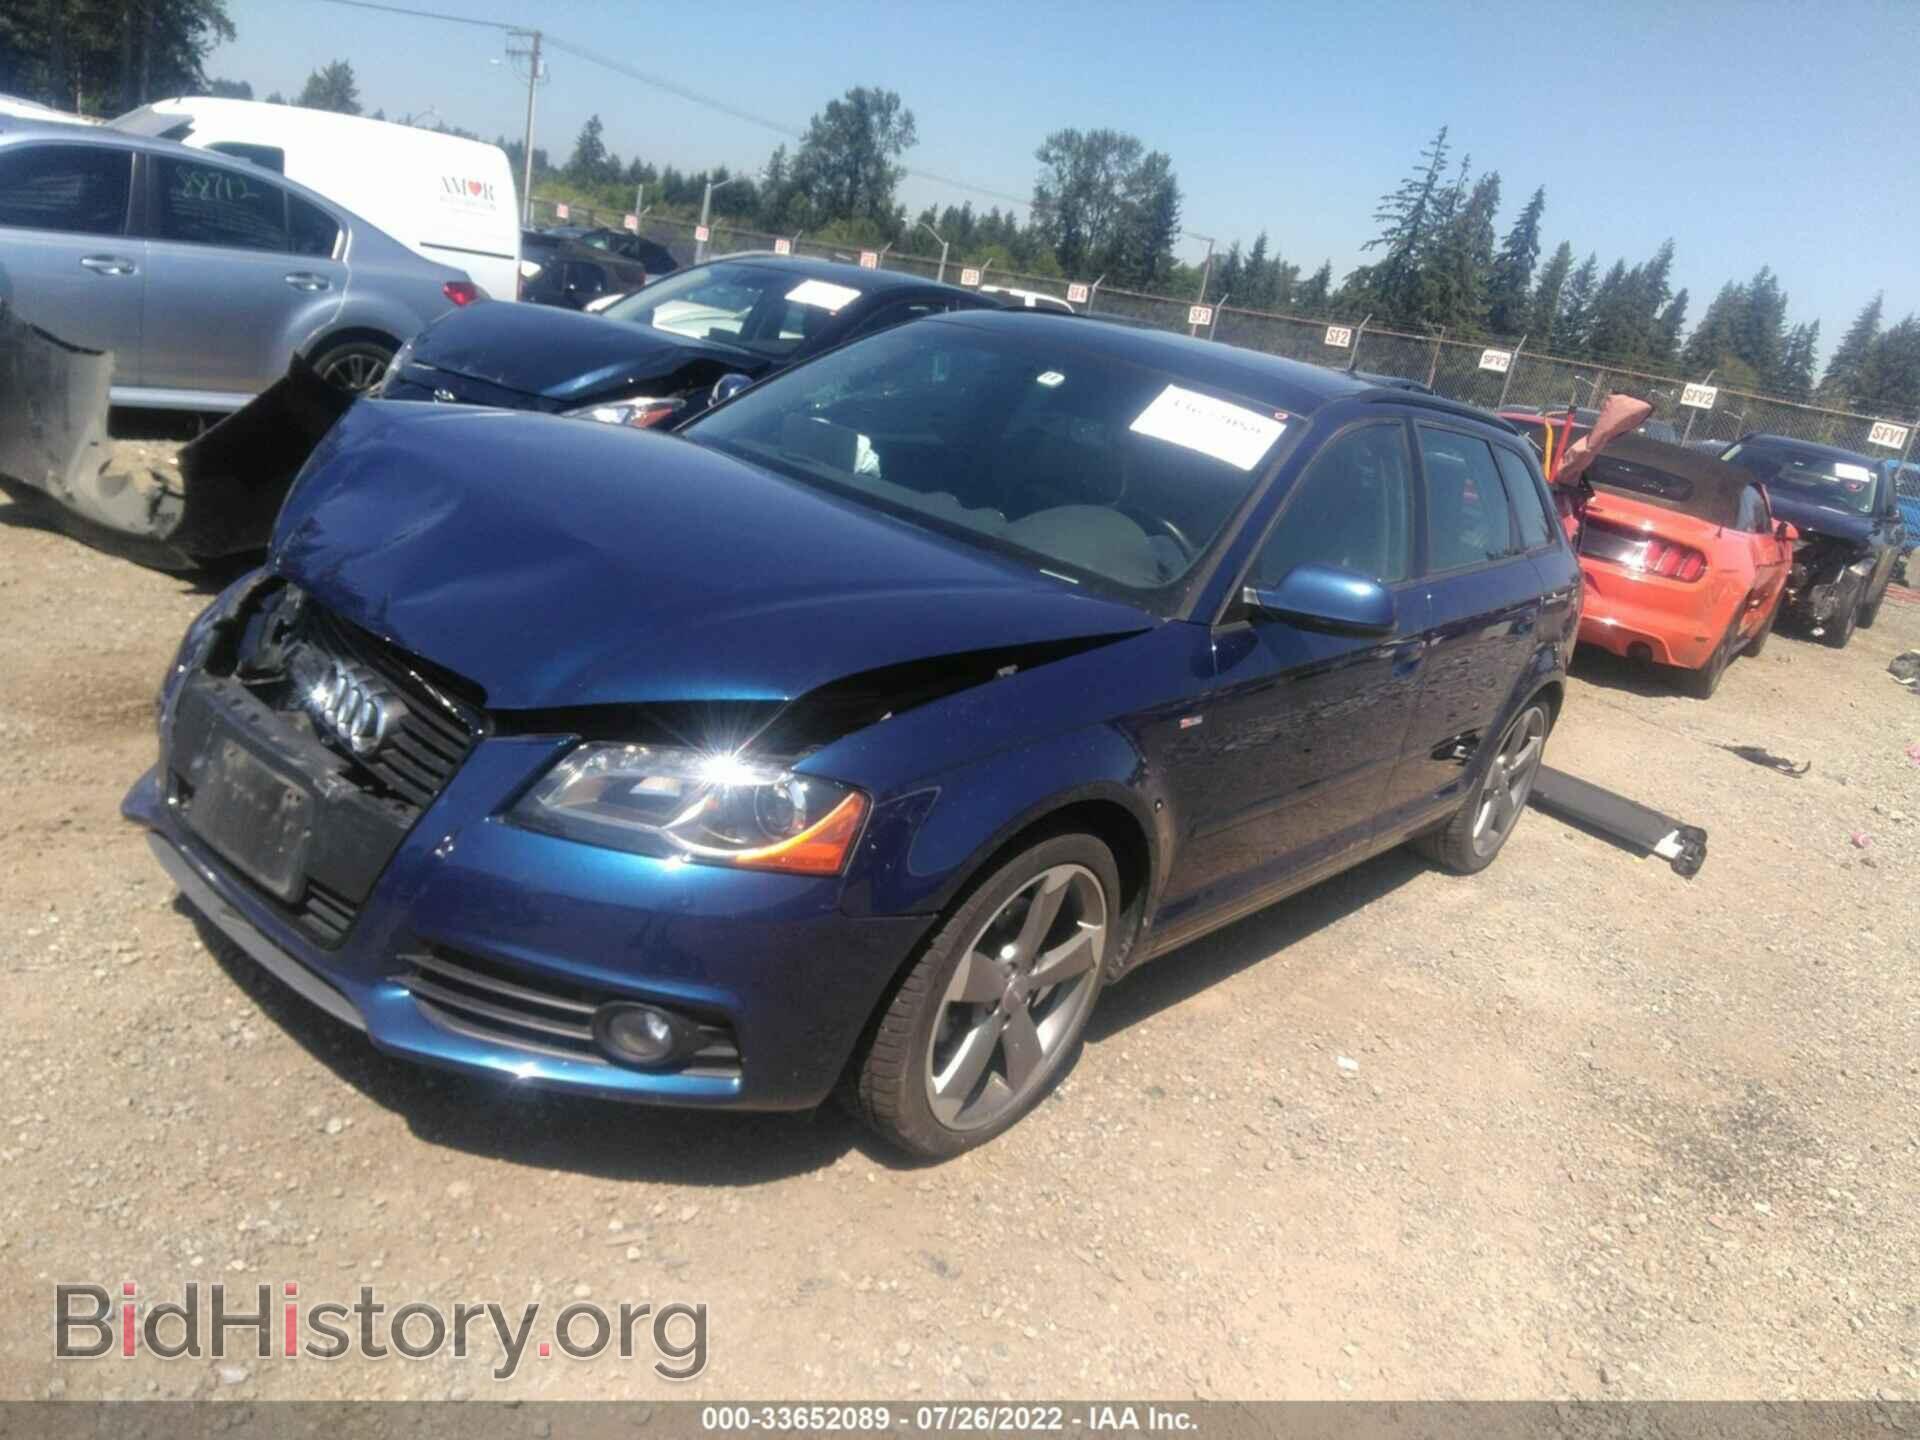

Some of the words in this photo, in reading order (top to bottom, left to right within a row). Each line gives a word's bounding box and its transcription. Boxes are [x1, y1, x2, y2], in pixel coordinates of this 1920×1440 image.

[1328, 327, 1350, 345] SF2
[1683, 388, 1714, 405] SFV2
[1872, 425, 1905, 445] SFV1
